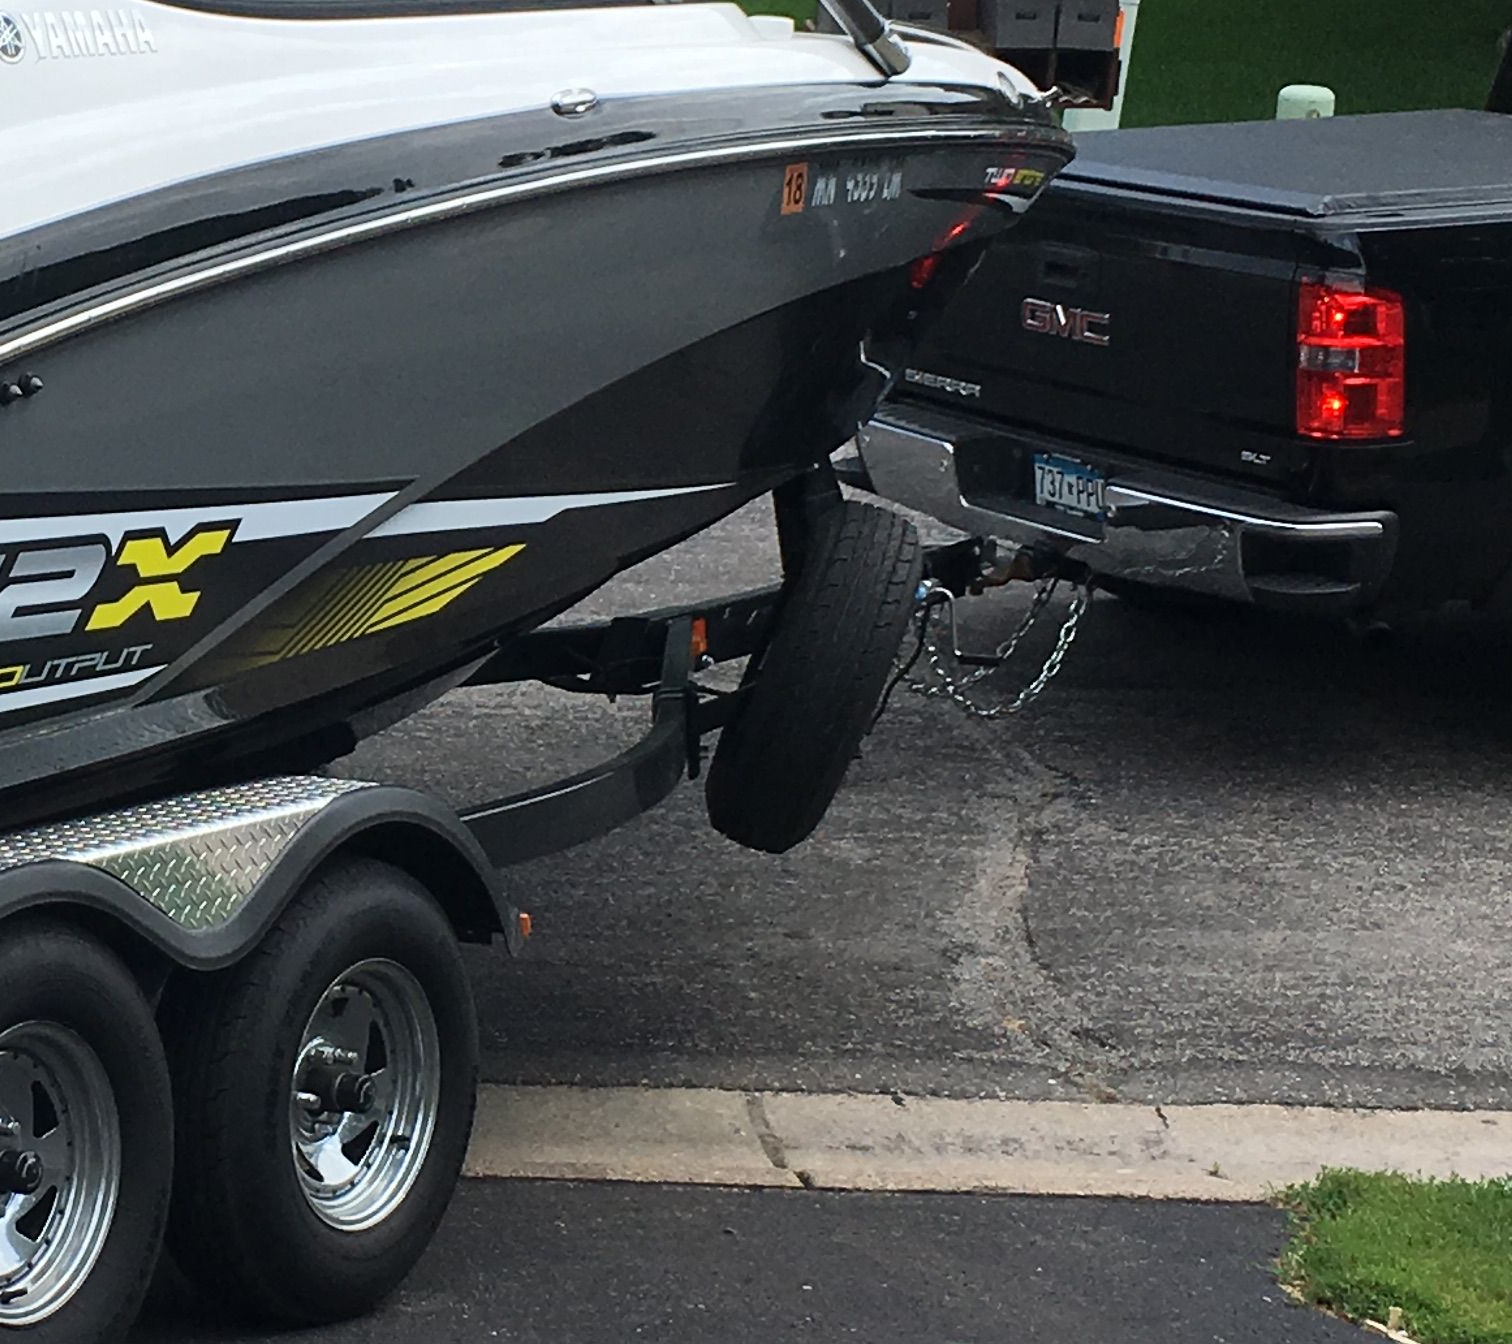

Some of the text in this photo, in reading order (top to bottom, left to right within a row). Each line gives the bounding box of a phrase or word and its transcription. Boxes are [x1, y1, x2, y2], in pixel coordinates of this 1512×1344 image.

[20, 9, 158, 61] YAMAHA
[785, 172, 805, 207] 18
[1022, 297, 1111, 346] GMC
[904, 367, 982, 398] SIERRA
